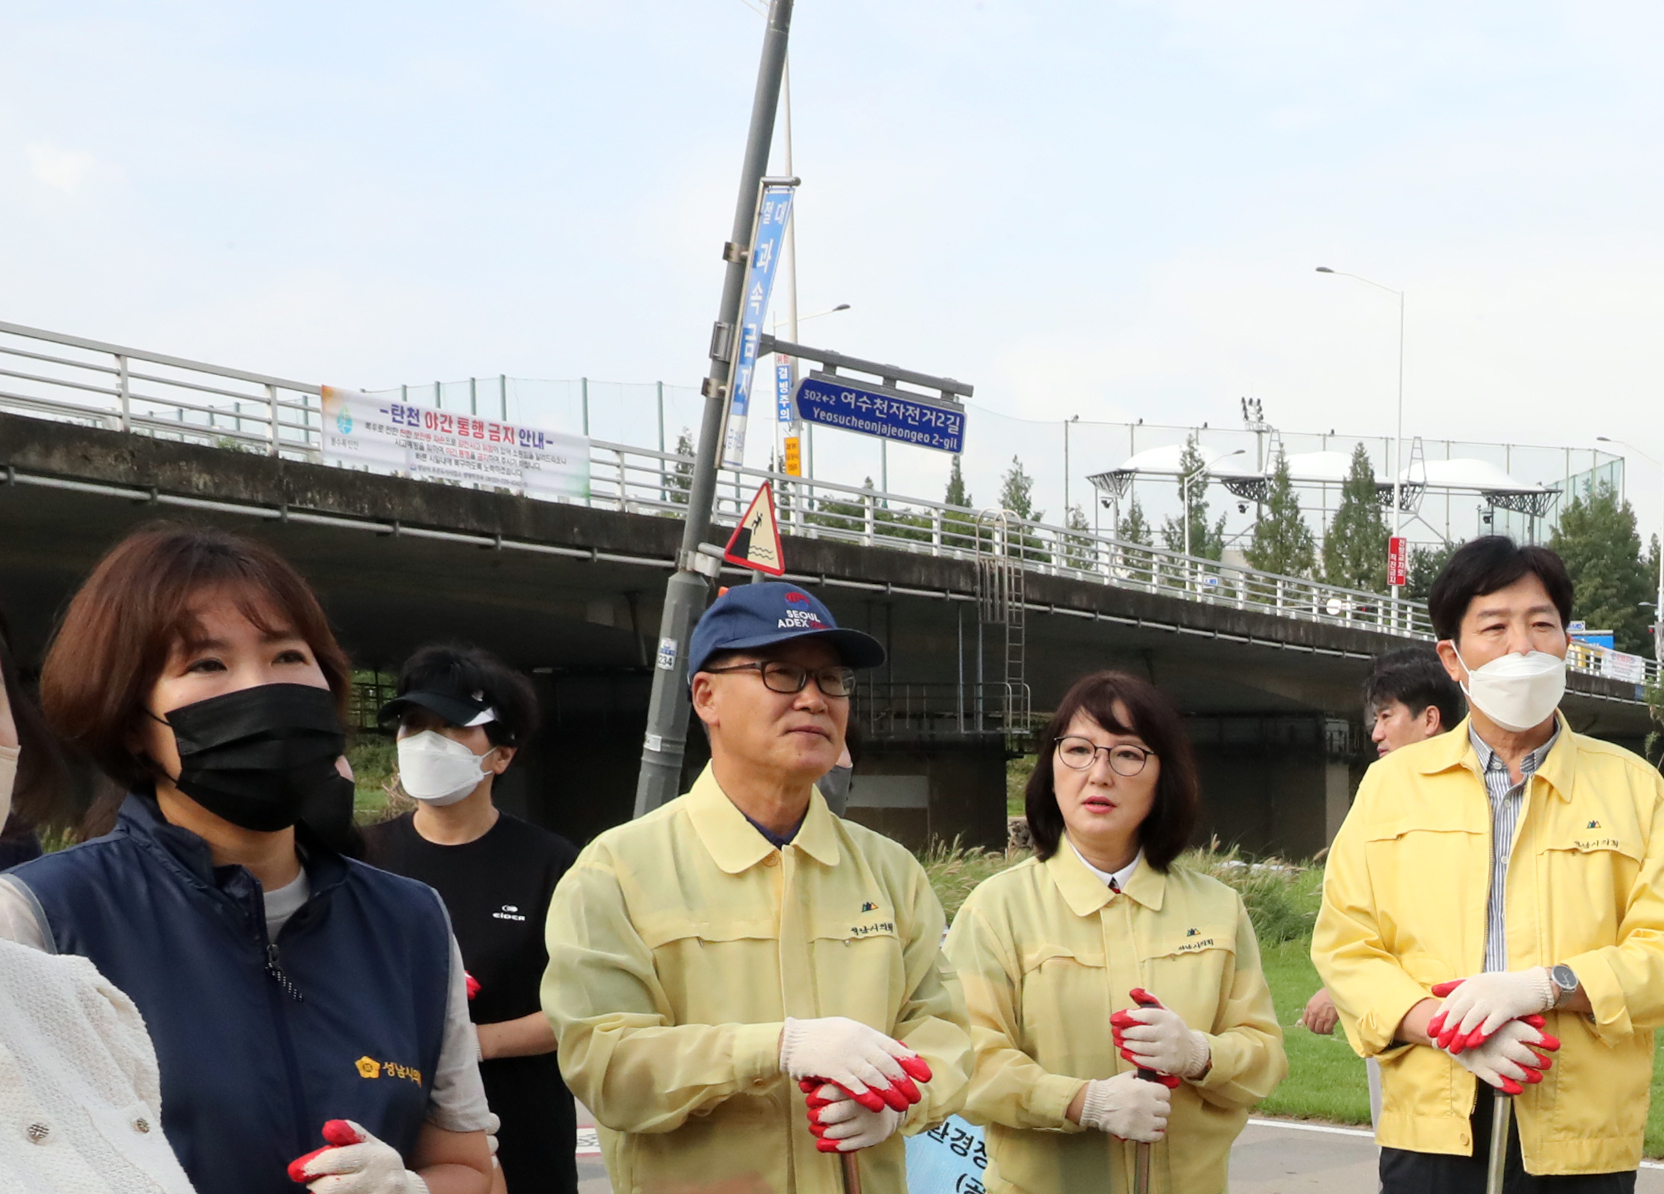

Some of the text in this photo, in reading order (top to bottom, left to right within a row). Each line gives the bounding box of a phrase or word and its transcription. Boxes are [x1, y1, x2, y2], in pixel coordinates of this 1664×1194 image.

[778, 366, 791, 421] 결빙주의
[425, 411, 453, 434] 야간
[457, 417, 485, 440] 통행
[488, 423, 515, 445] 금지
[813, 407, 957, 450] Yeosucheonjajeongeo 2-gil
[841, 391, 960, 436] 여수천자전거2길
[778, 618, 810, 629] ADEX
[786, 610, 821, 623] SEOUL
